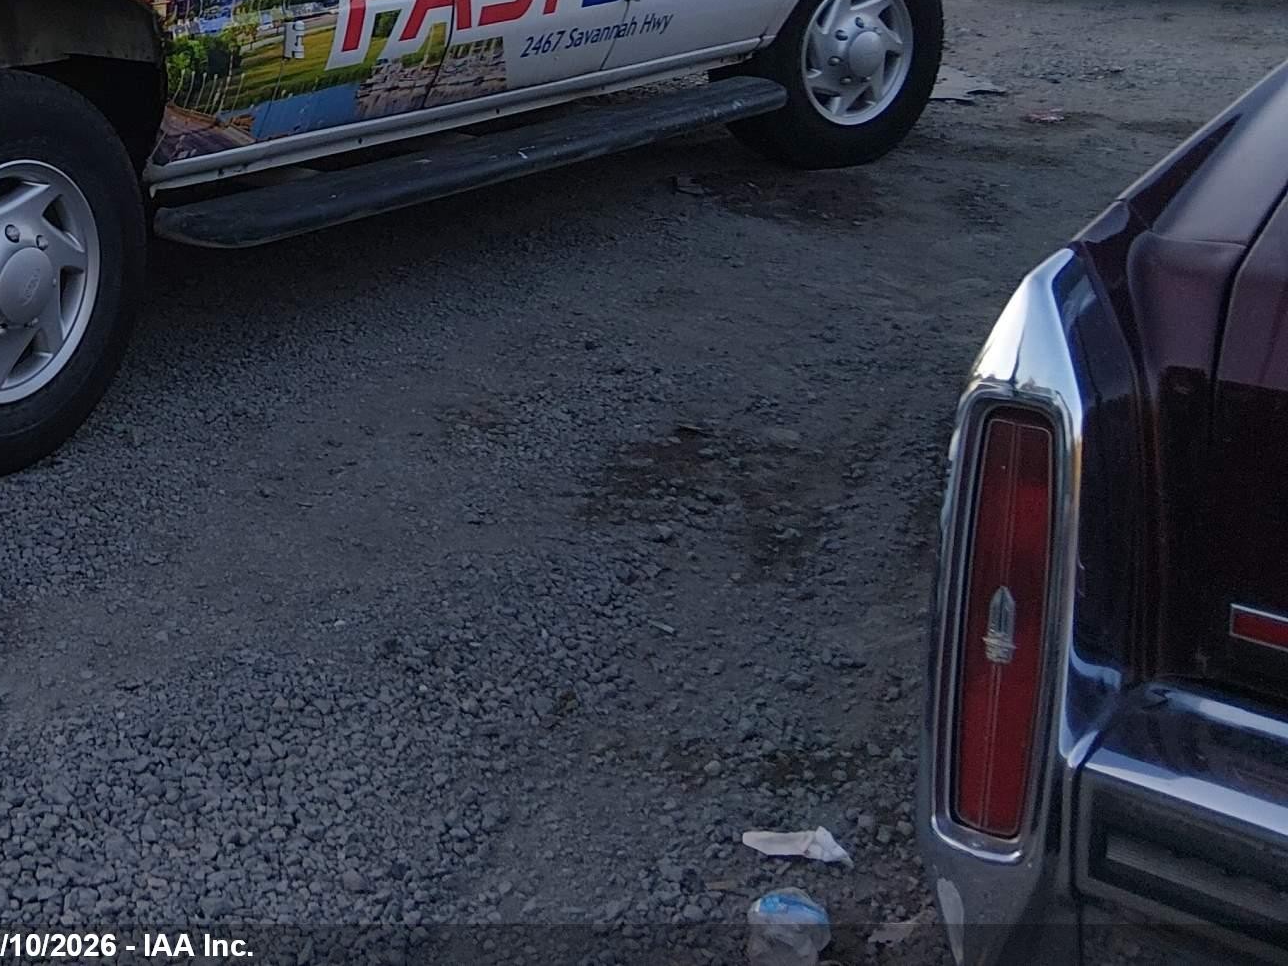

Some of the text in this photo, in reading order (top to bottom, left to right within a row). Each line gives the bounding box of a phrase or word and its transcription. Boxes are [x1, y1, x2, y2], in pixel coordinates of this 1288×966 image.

[519, 12, 675, 59] 2467 Savannah Hwy
